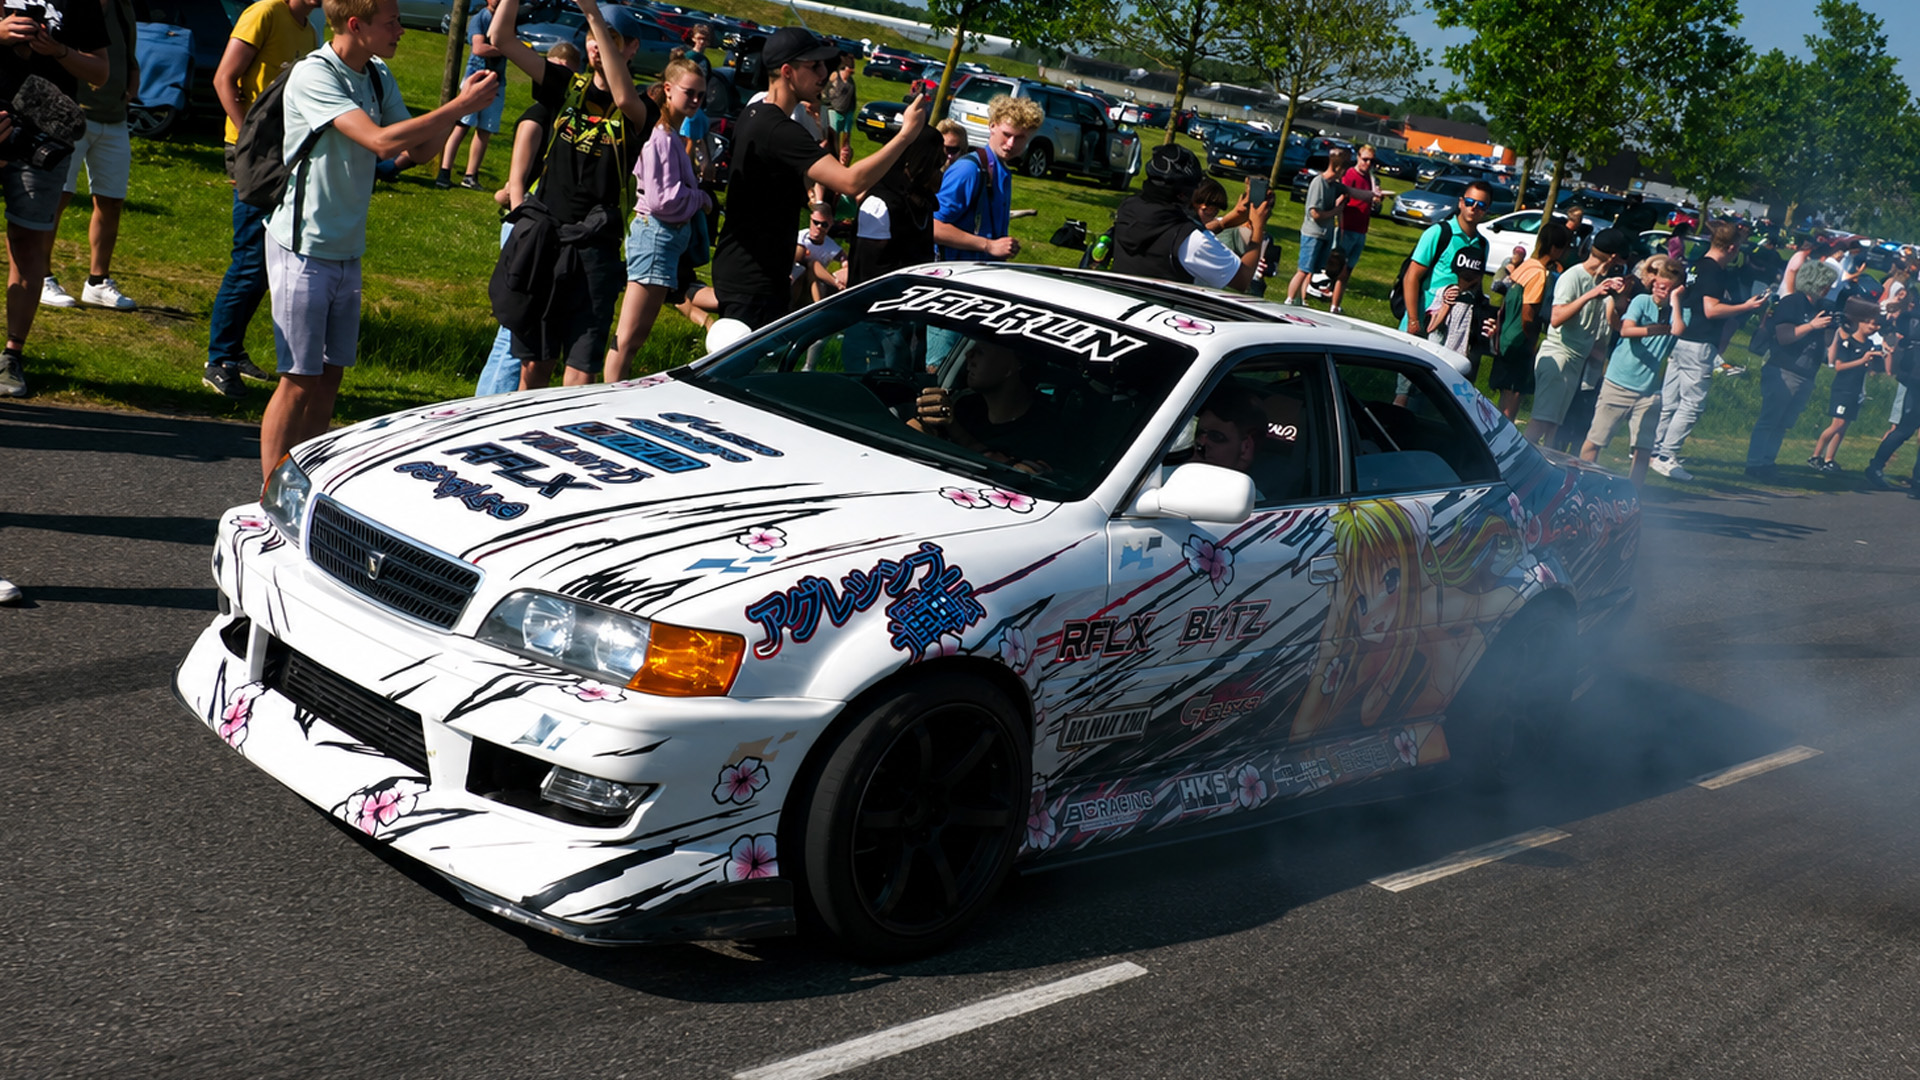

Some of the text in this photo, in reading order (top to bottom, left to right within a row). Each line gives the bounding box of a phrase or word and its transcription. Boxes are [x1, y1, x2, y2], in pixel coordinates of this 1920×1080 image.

[867, 285, 1148, 362] JAPRUN
[1055, 614, 1157, 663] RFLX
[1181, 774, 1228, 799] HKS
